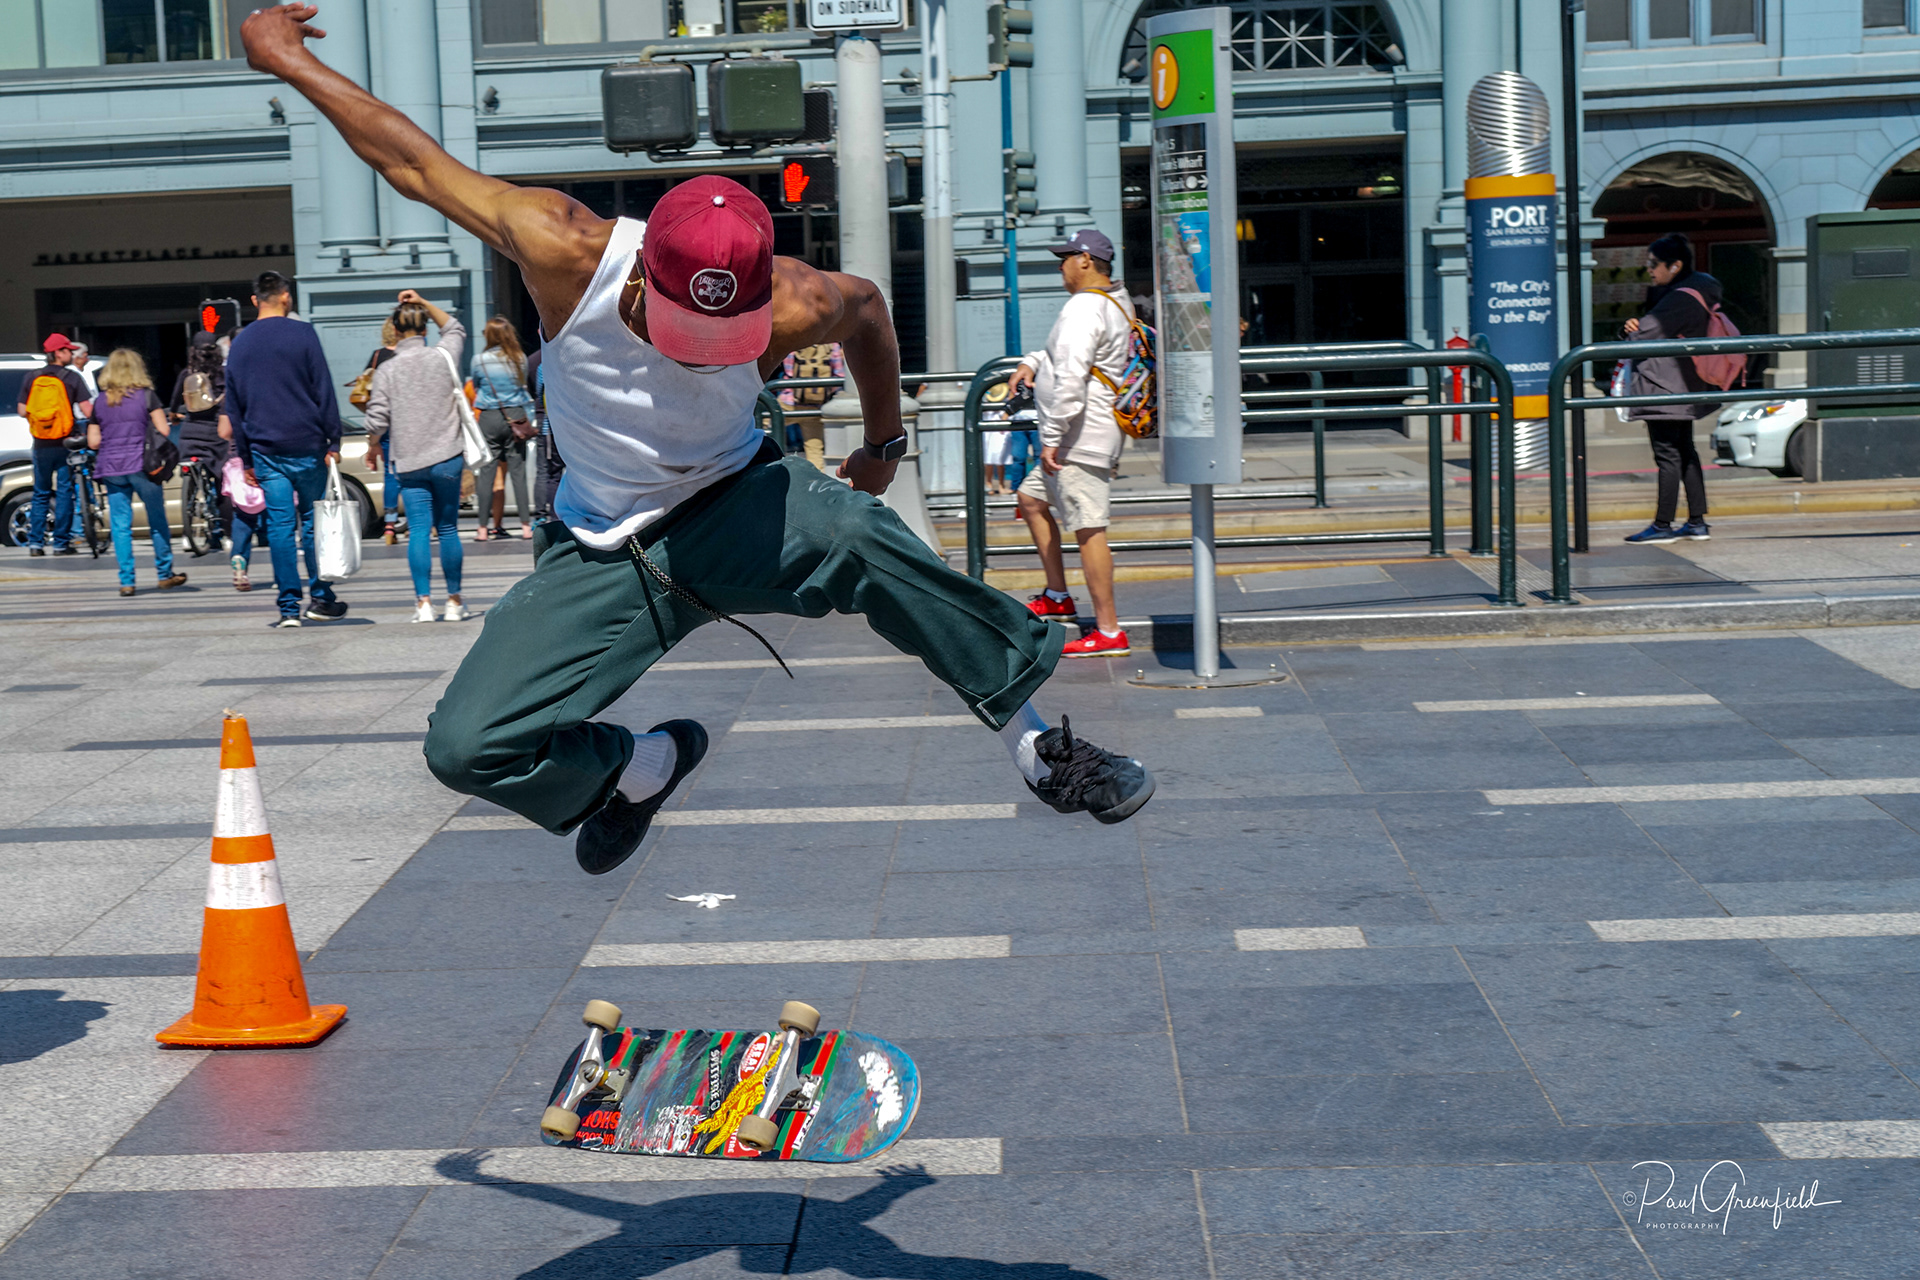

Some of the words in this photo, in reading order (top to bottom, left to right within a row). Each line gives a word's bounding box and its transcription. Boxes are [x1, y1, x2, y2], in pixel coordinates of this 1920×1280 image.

[818, 2, 833, 15] ON
[839, 0, 893, 14] SIDEWALK
[1490, 205, 1548, 228] PORT
[1485, 228, 1503, 237] SAN
[1504, 226, 1550, 235] FRANCISCO
[37, 248, 201, 264] MARKETPLACE
[1521, 280, 1550, 294] City's
[1487, 296, 1552, 309] Connection
[1488, 313, 1502, 324] to
[1504, 310, 1525, 323] the
[744, 1042, 766, 1073] REAL
[710, 1049, 721, 1101] SPITFIRE
